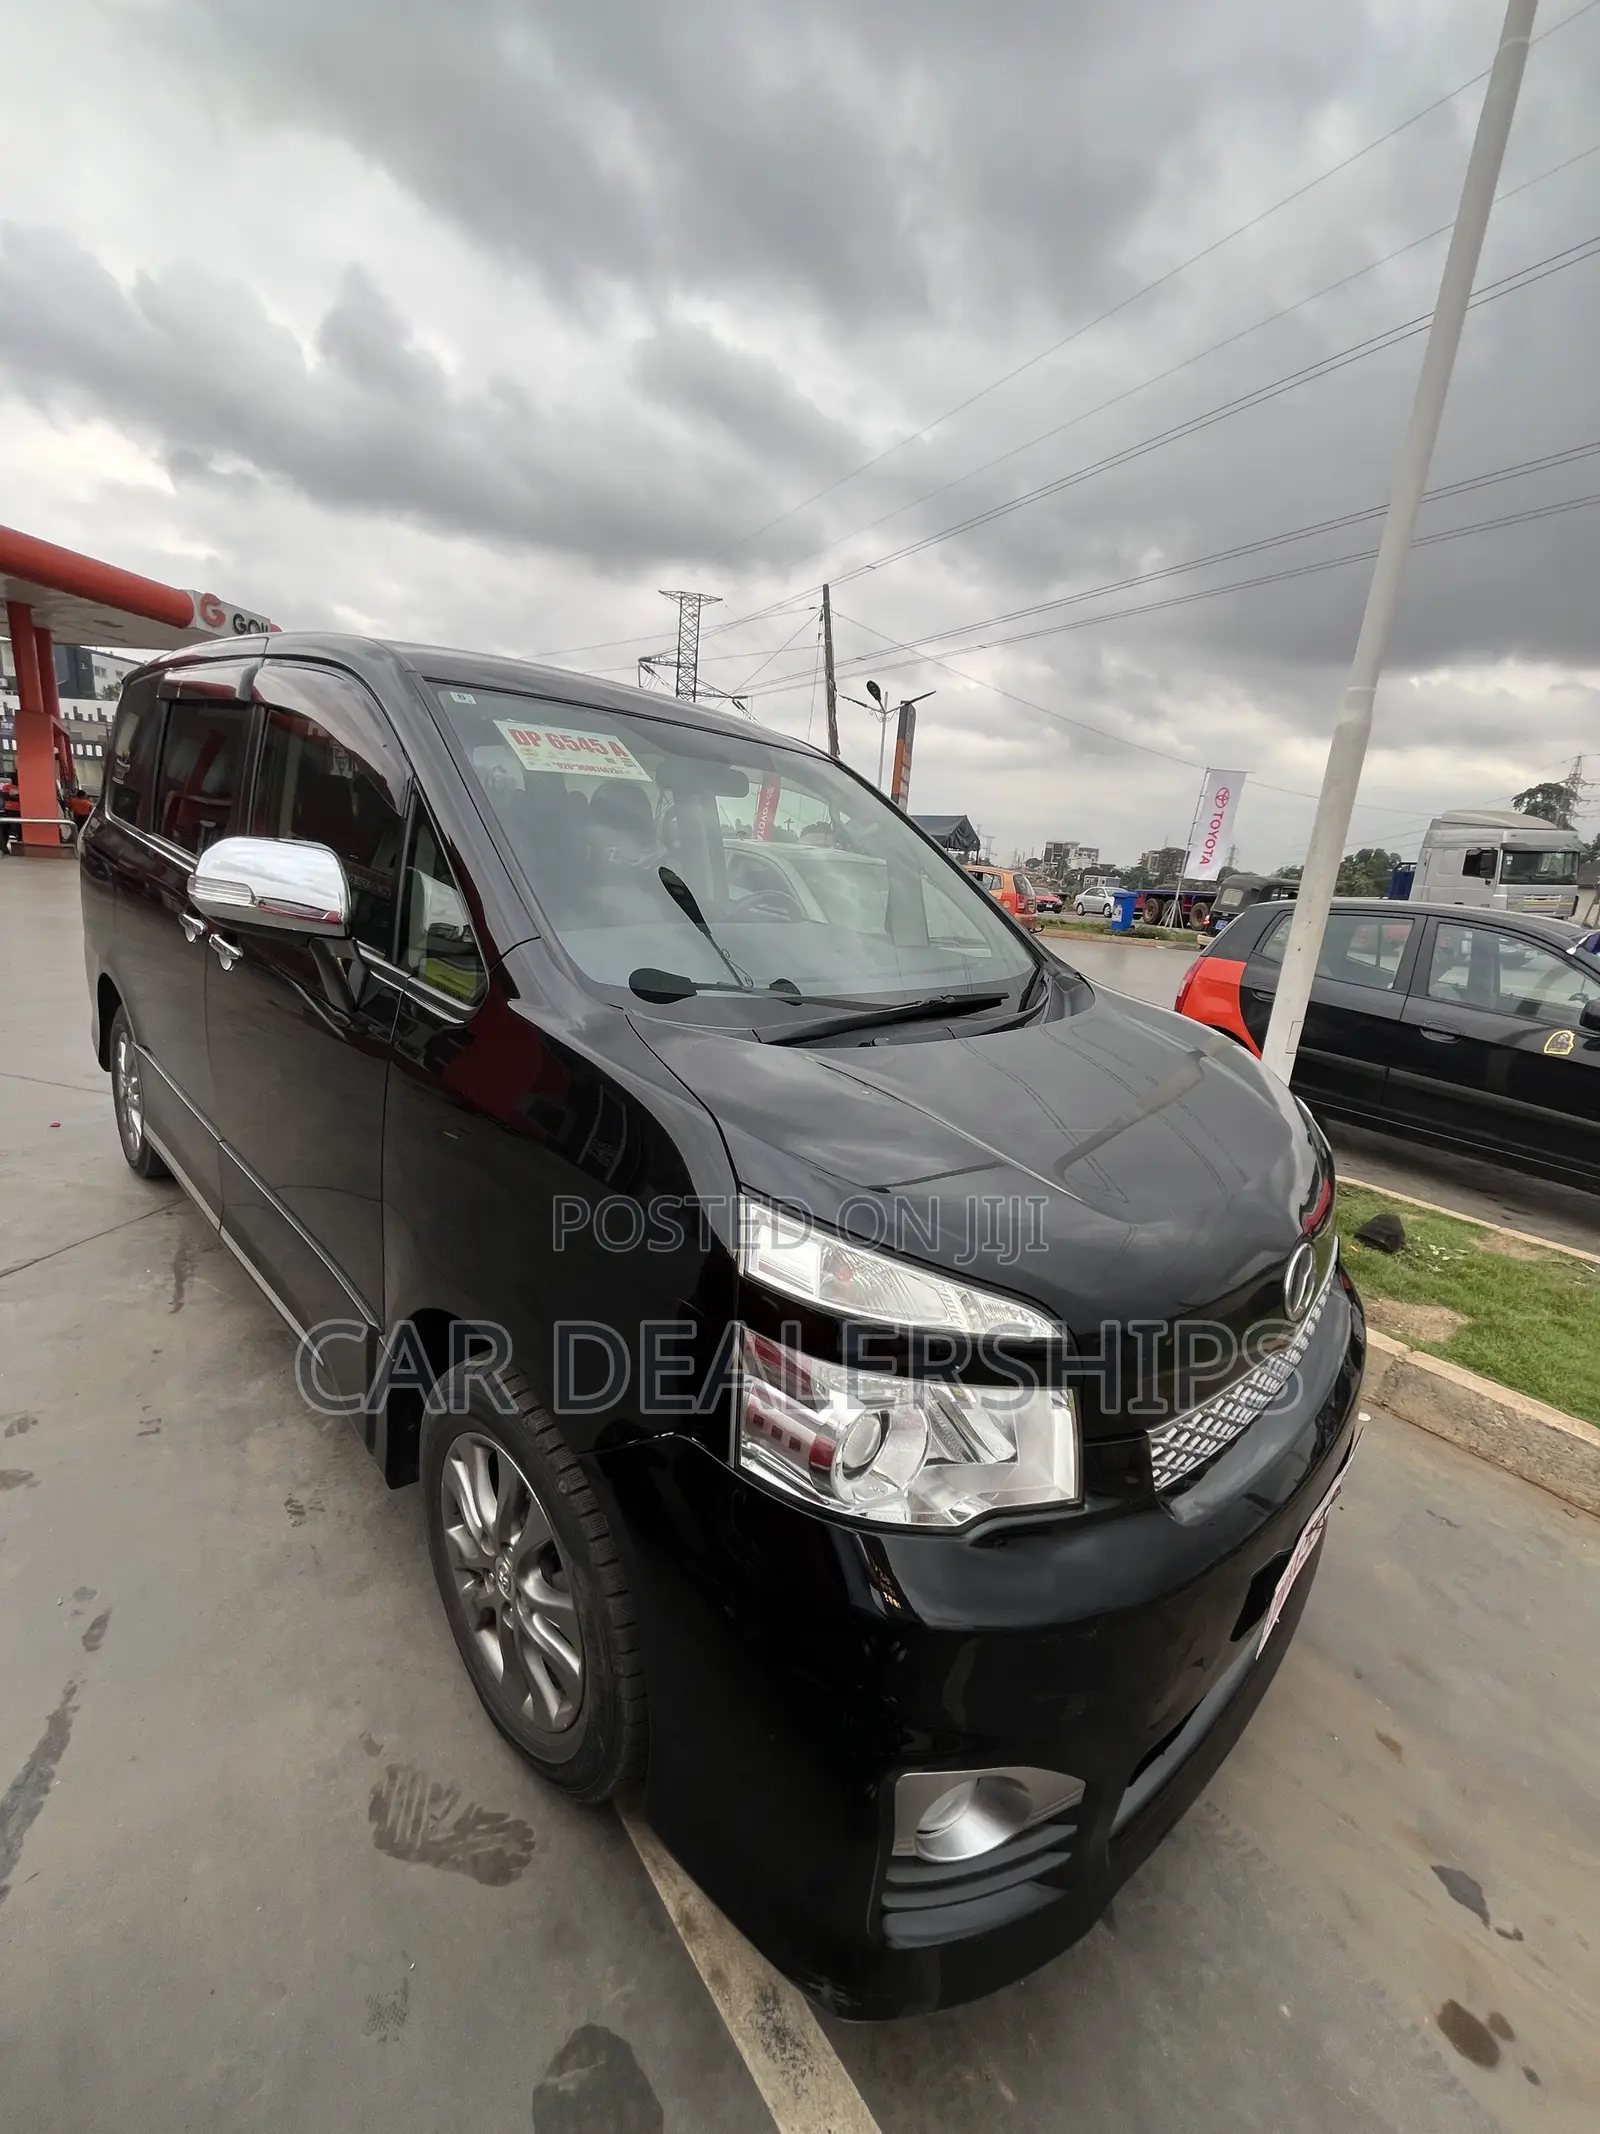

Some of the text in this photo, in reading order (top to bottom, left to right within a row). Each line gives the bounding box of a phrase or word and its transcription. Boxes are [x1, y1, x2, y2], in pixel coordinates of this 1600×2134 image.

[507, 728, 543, 748] DP
[544, 732, 610, 755] 6545
[607, 741, 629, 758] A
[1199, 810, 1225, 865] TOYOTA
